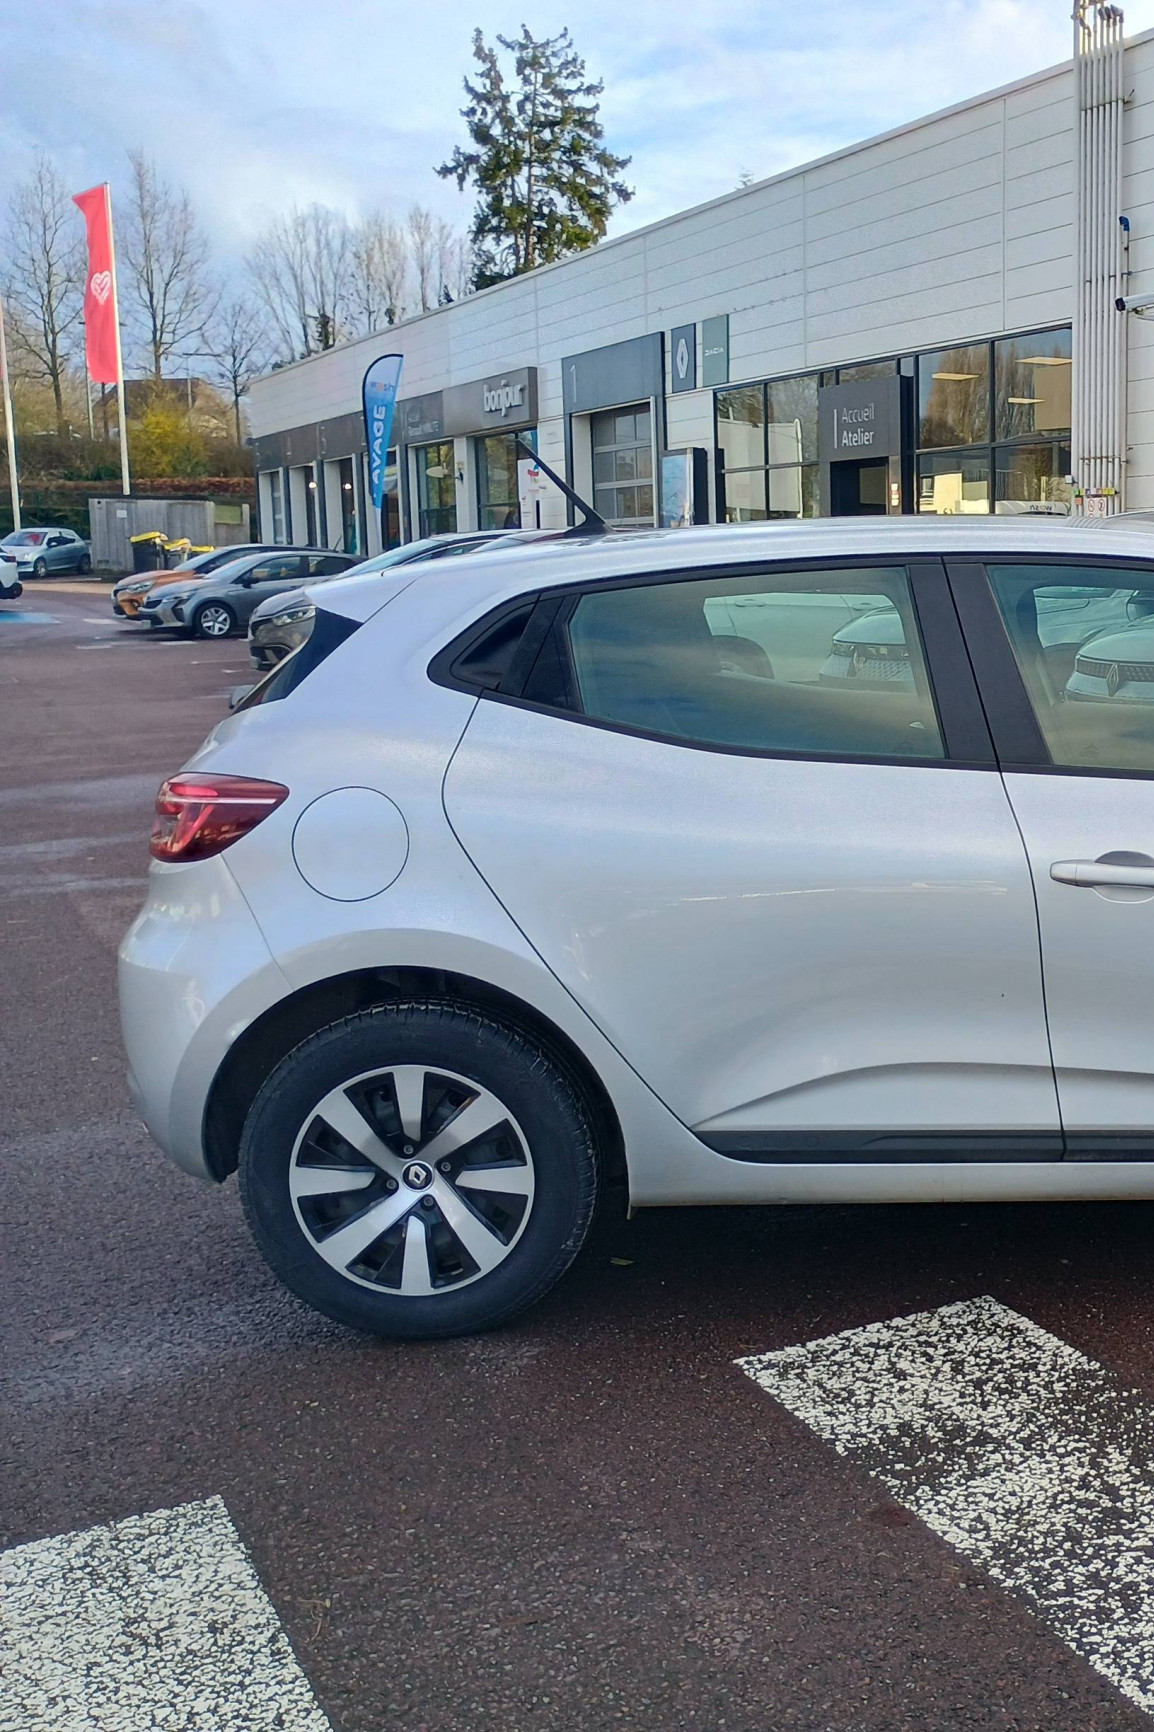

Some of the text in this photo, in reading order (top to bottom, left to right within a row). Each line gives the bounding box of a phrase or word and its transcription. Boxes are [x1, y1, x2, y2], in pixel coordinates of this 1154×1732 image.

[483, 379, 526, 418] bonjour
[841, 402, 875, 424] Accueil
[371, 404, 387, 497] AVAGE
[841, 427, 875, 447] Atelier
